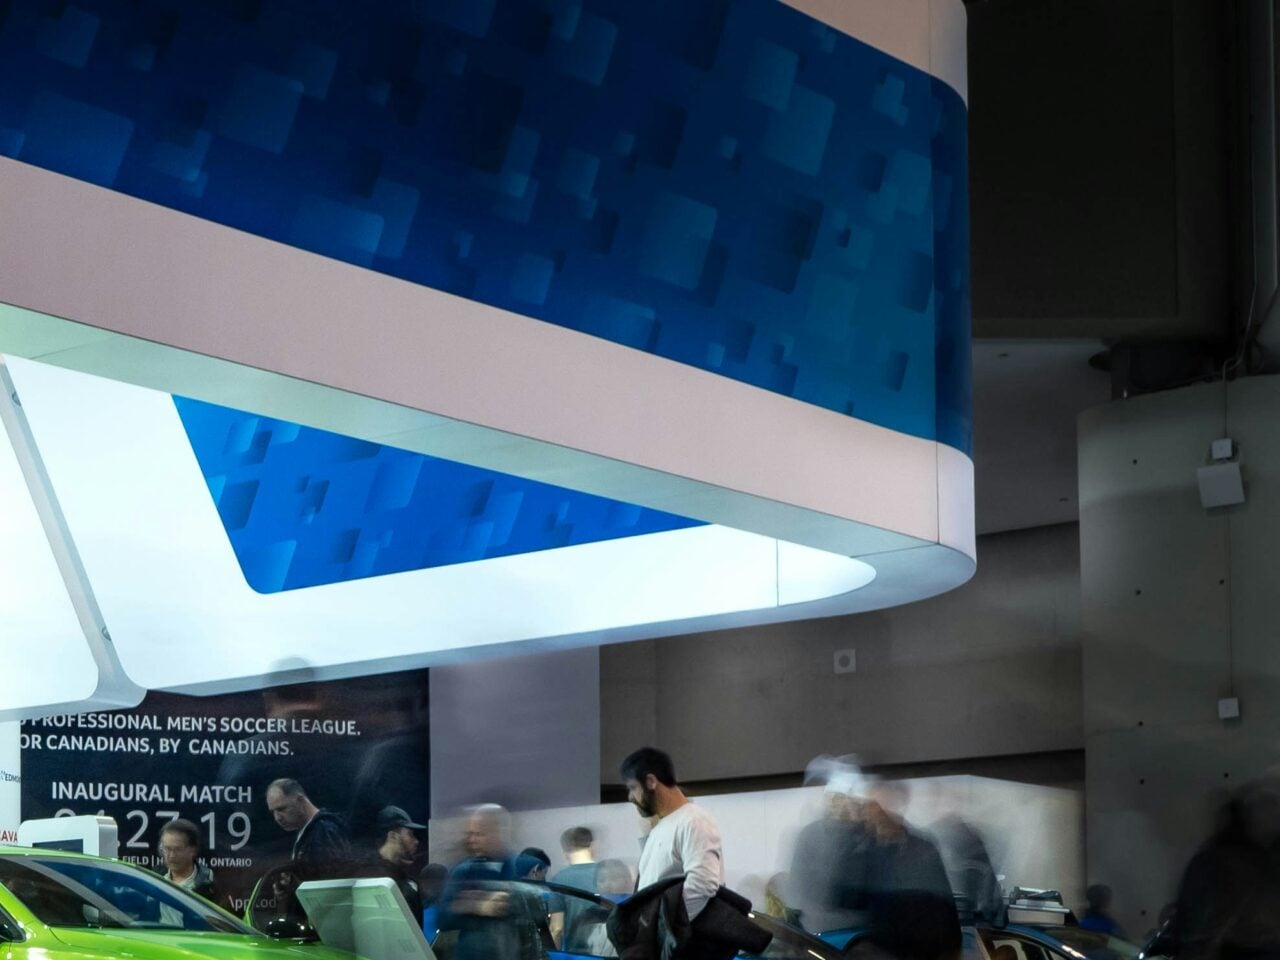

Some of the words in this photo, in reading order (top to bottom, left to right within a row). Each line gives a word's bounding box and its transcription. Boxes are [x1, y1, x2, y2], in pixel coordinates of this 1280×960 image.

[167, 716, 216, 732] MEN'S
[220, 717, 287, 733] SOCCER
[291, 719, 361, 736] LEAGUE.
[46, 734, 154, 755] CANADIANS,
[159, 738, 181, 753] BY
[189, 739, 294, 756] CANADIANS.
[52, 781, 175, 802] INAUGURAL
[181, 784, 252, 804] MATCH
[210, 857, 252, 867] ONTARIO
